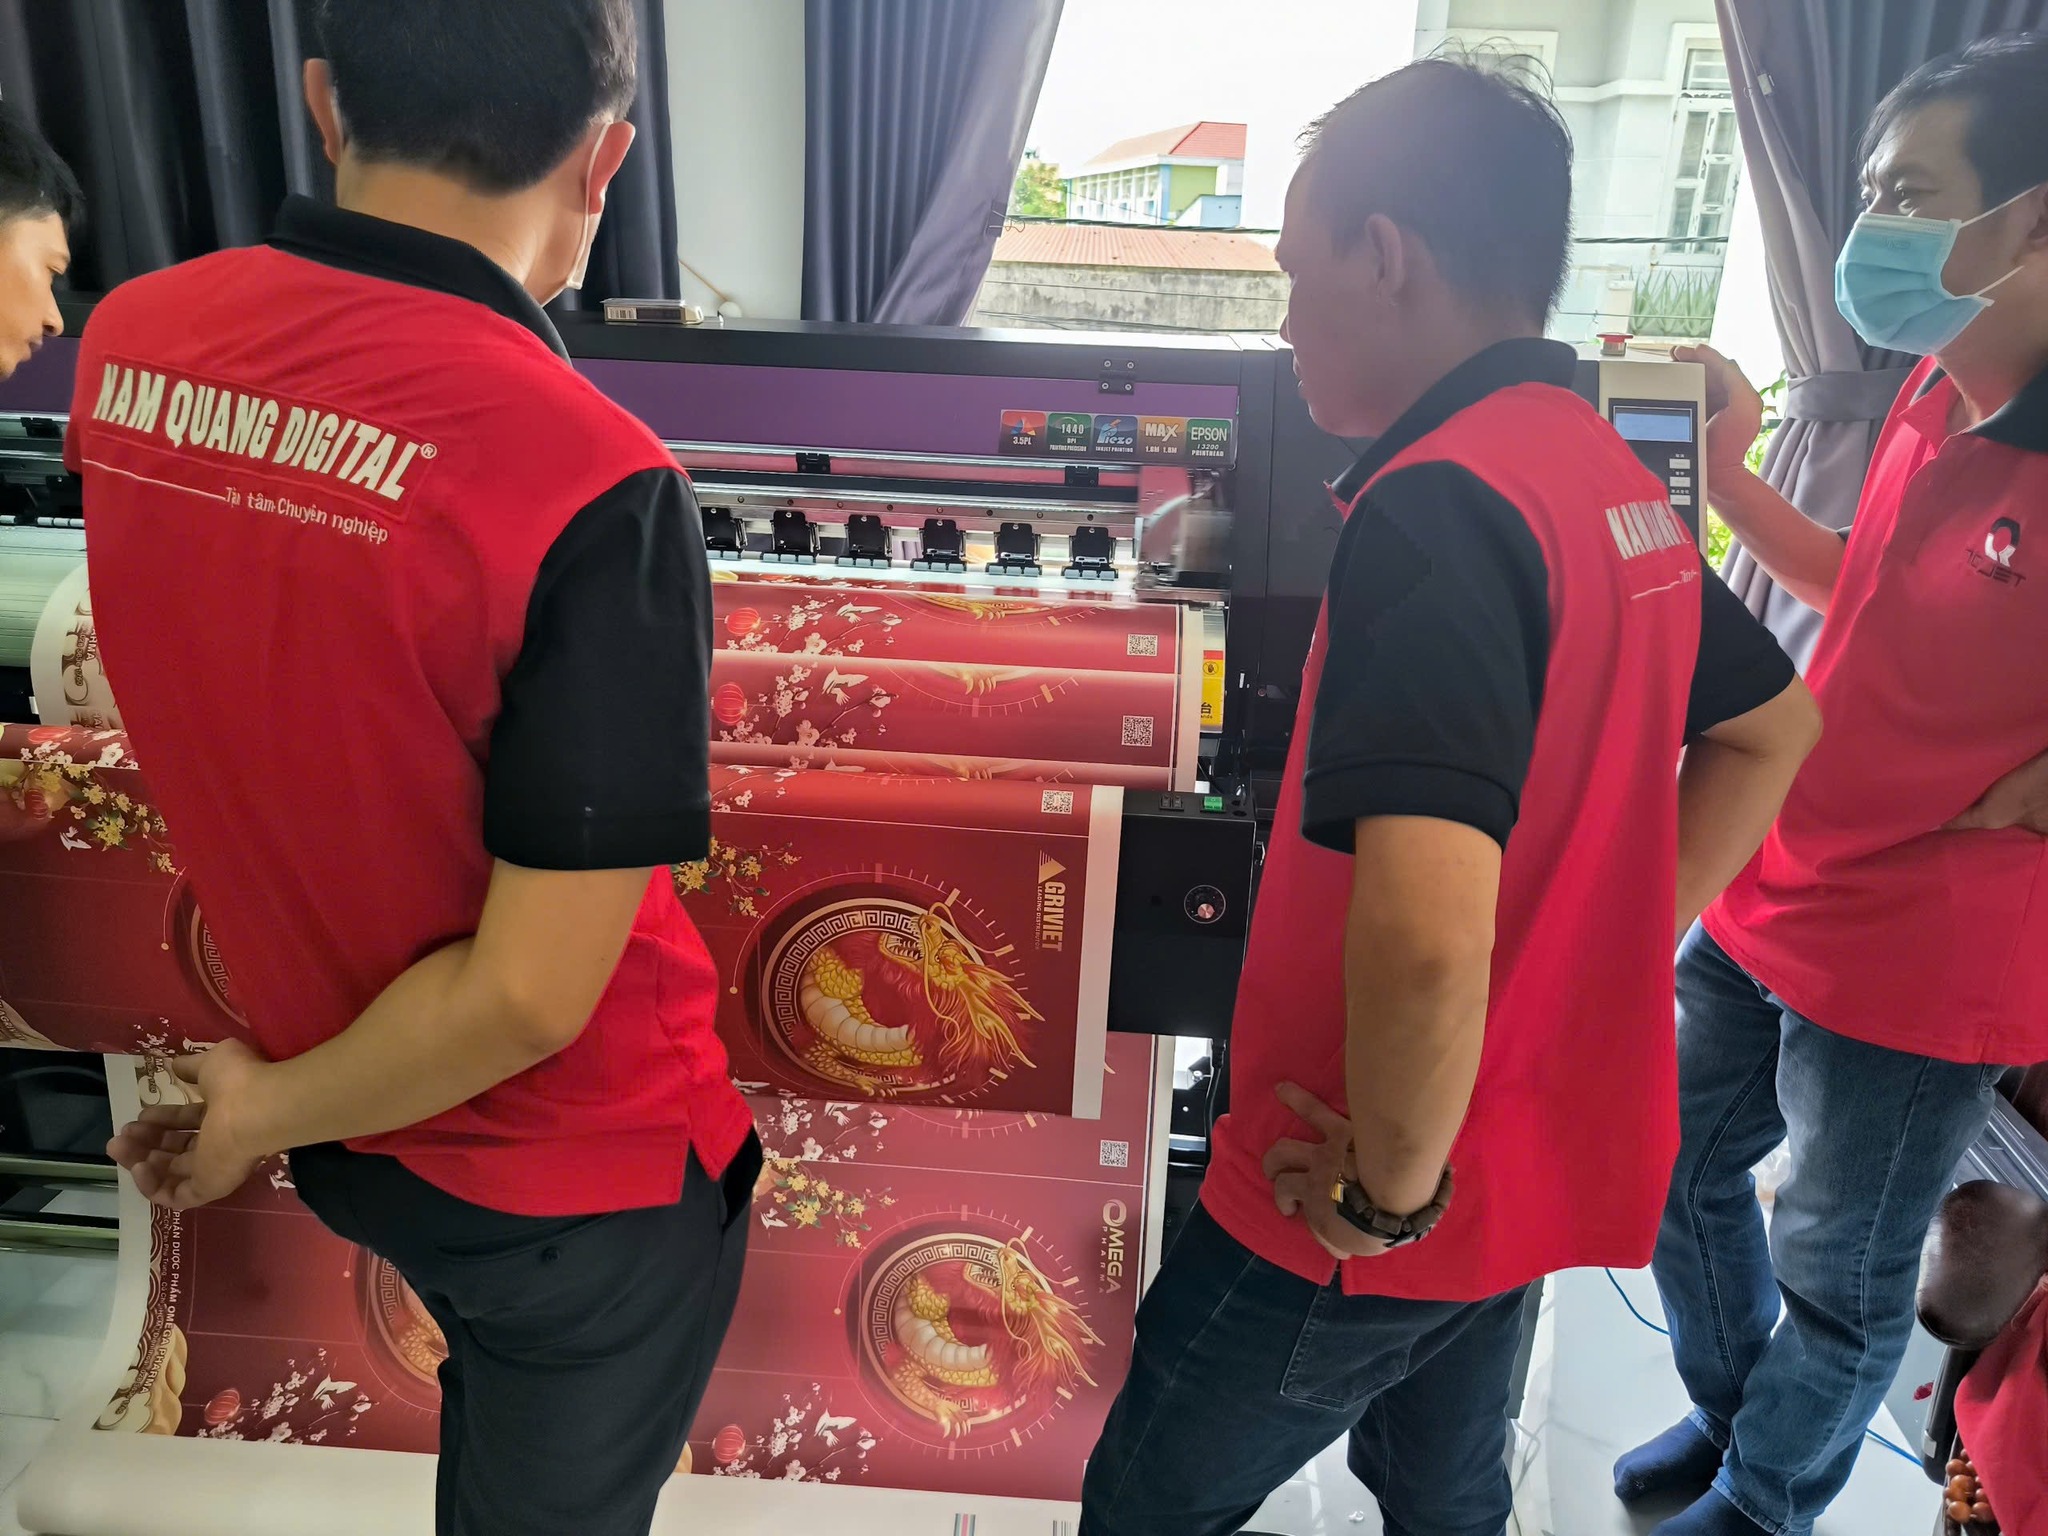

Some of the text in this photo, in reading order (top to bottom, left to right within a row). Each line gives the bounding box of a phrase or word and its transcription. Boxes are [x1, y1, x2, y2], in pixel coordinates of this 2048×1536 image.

[92, 363, 166, 433] NAM
[165, 380, 280, 459] QUANG
[1061, 424, 1084, 434] 1440
[1013, 436, 1031, 445] 3.5PL
[1191, 426, 1227, 442] EPSON
[1099, 1226, 1108, 1294] PHARMA
[1102, 1199, 1127, 1294] OMEGA
[160, 1305, 176, 1345] OMEGA
[140, 1348, 168, 1394] PHARMA
